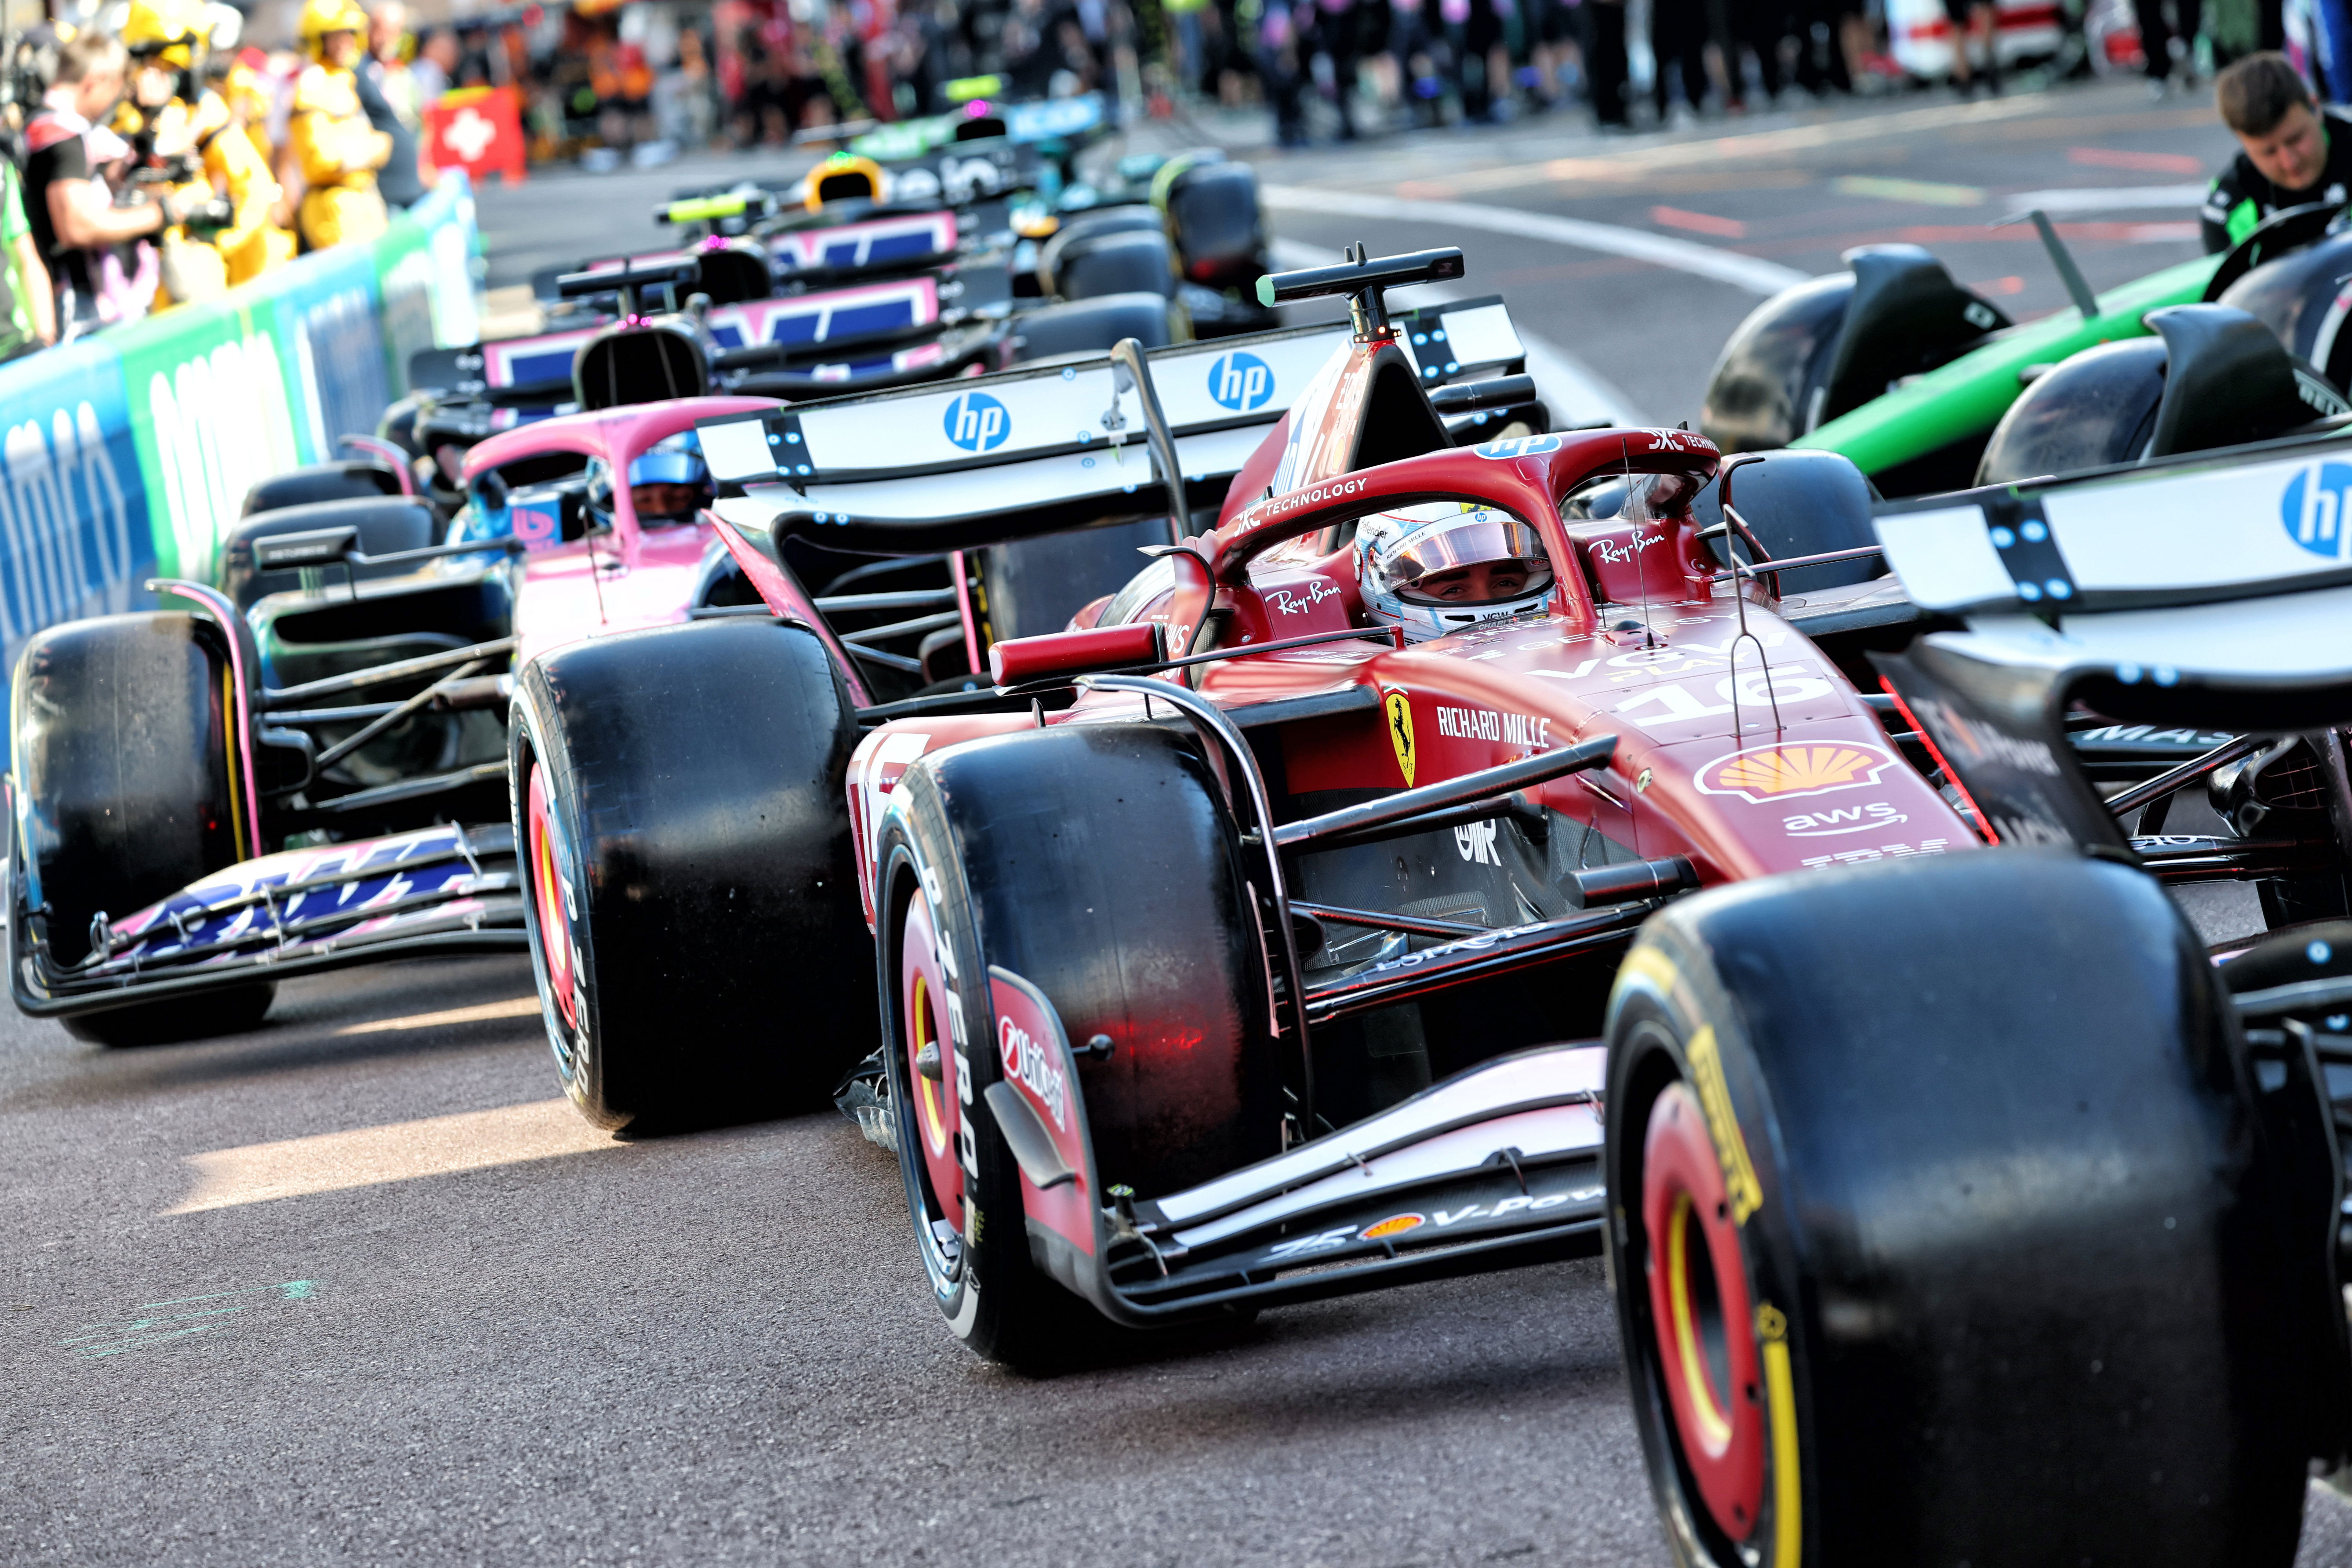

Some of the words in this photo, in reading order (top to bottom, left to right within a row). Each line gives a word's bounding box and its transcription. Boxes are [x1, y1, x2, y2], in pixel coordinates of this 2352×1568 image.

[1218, 352, 1267, 410] hp
[955, 392, 1004, 452] hp
[1682, 435, 1721, 453] TECHNOL
[1266, 478, 1367, 517] TECHNOLOGY
[1476, 512, 1486, 522] hp
[1386, 542, 1407, 561] RICHARD
[1408, 531, 1426, 544] MILLE
[1517, 610, 1782, 651] GEESYS
[1523, 632, 1789, 679] VGW
[1604, 651, 1751, 682] PLAY
[1615, 665, 1835, 727] 16
[1436, 706, 1500, 741] RICHARD
[1503, 713, 1551, 748] MILLE
[1783, 802, 1897, 831] aws
[569, 935, 591, 1097] ZERO
[936, 930, 980, 1180] ZERO
[1431, 1185, 1607, 1228] V-Pow
